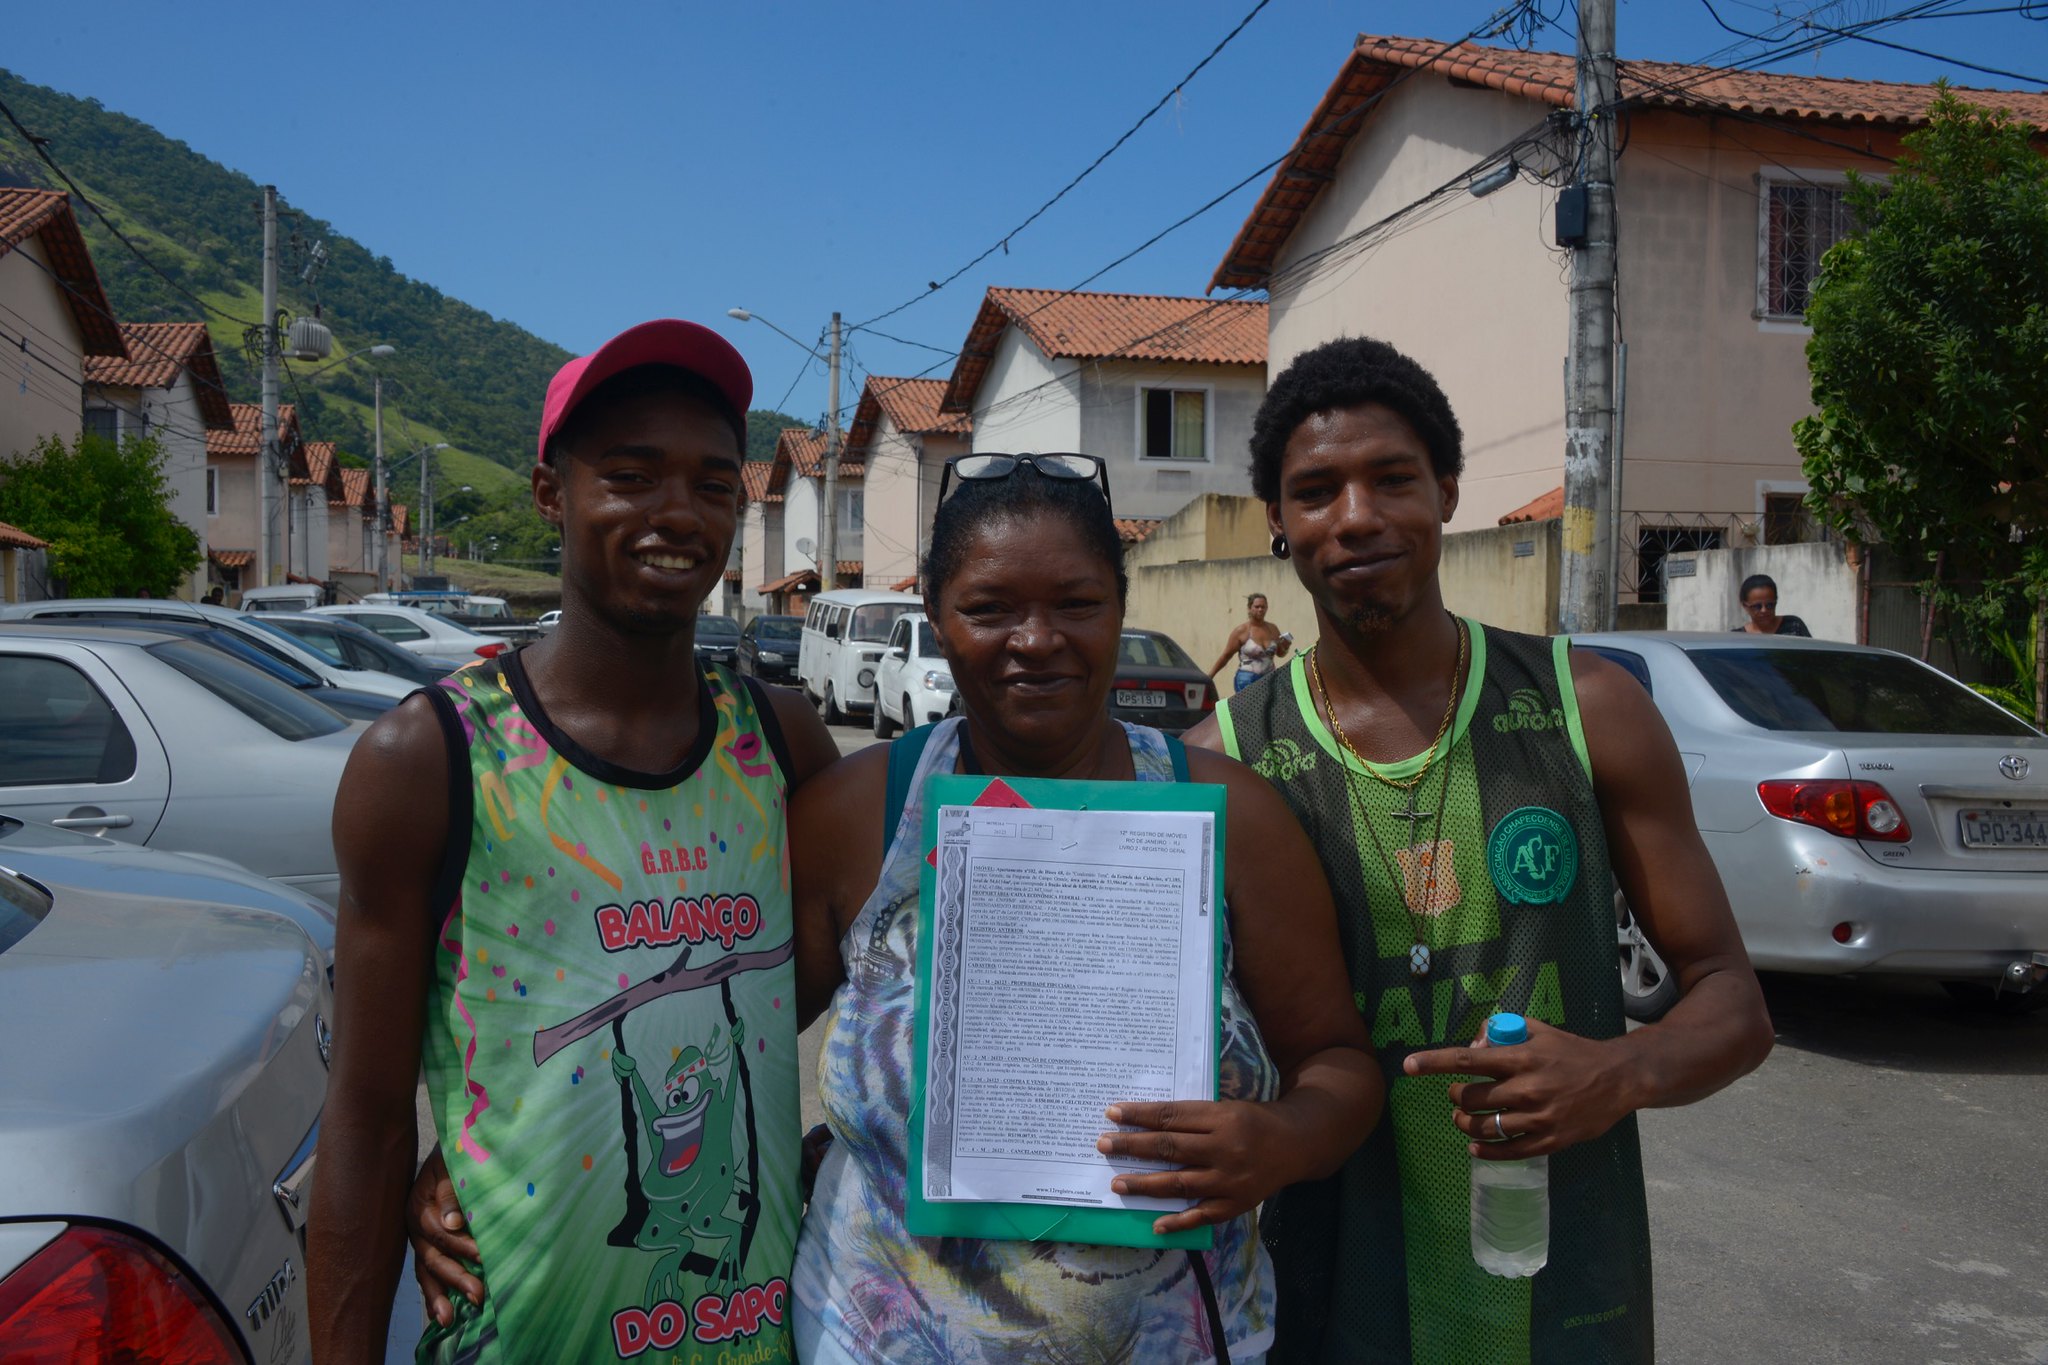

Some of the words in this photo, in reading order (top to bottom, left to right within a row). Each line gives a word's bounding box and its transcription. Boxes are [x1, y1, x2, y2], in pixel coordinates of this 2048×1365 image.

[1504, 814, 1564, 834] CHAPECOENSE
[595, 893, 760, 951] BALANÇO
[946, 939, 952, 950] DO
[1354, 961, 1566, 1049] AIXA
[612, 1299, 688, 1358] DO
[692, 1276, 788, 1344] SAPO
